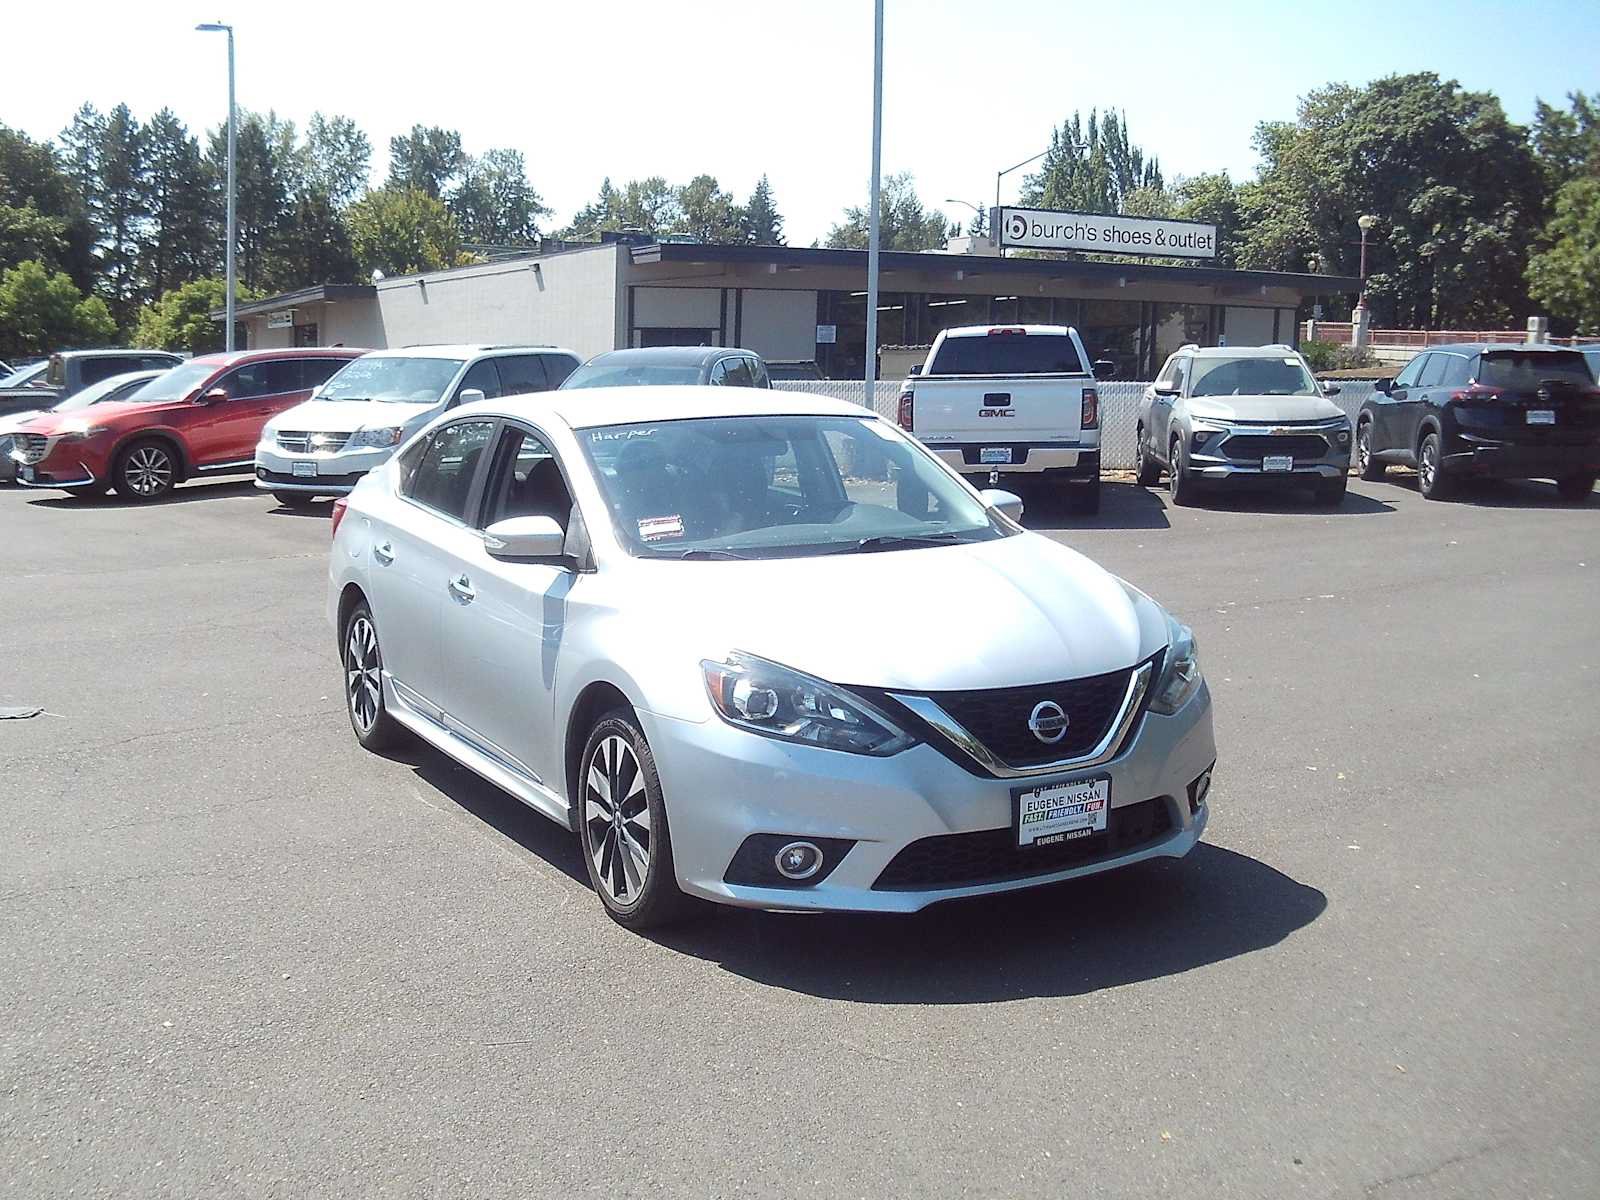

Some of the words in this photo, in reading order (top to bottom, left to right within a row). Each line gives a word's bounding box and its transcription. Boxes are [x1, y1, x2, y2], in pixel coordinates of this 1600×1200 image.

[1031, 219, 1097, 241] burch's
[1103, 226, 1152, 244] shoes
[1154, 228, 1166, 246] &
[1168, 232, 1213, 249] outlet
[978, 409, 1016, 418] GMC
[591, 428, 658, 443] Harper
[1027, 797, 1064, 812] EUGENE
[1066, 789, 1101, 804] NISSAN
[1036, 833, 1064, 847] EUGENE
[1066, 828, 1092, 841] NISSAN
